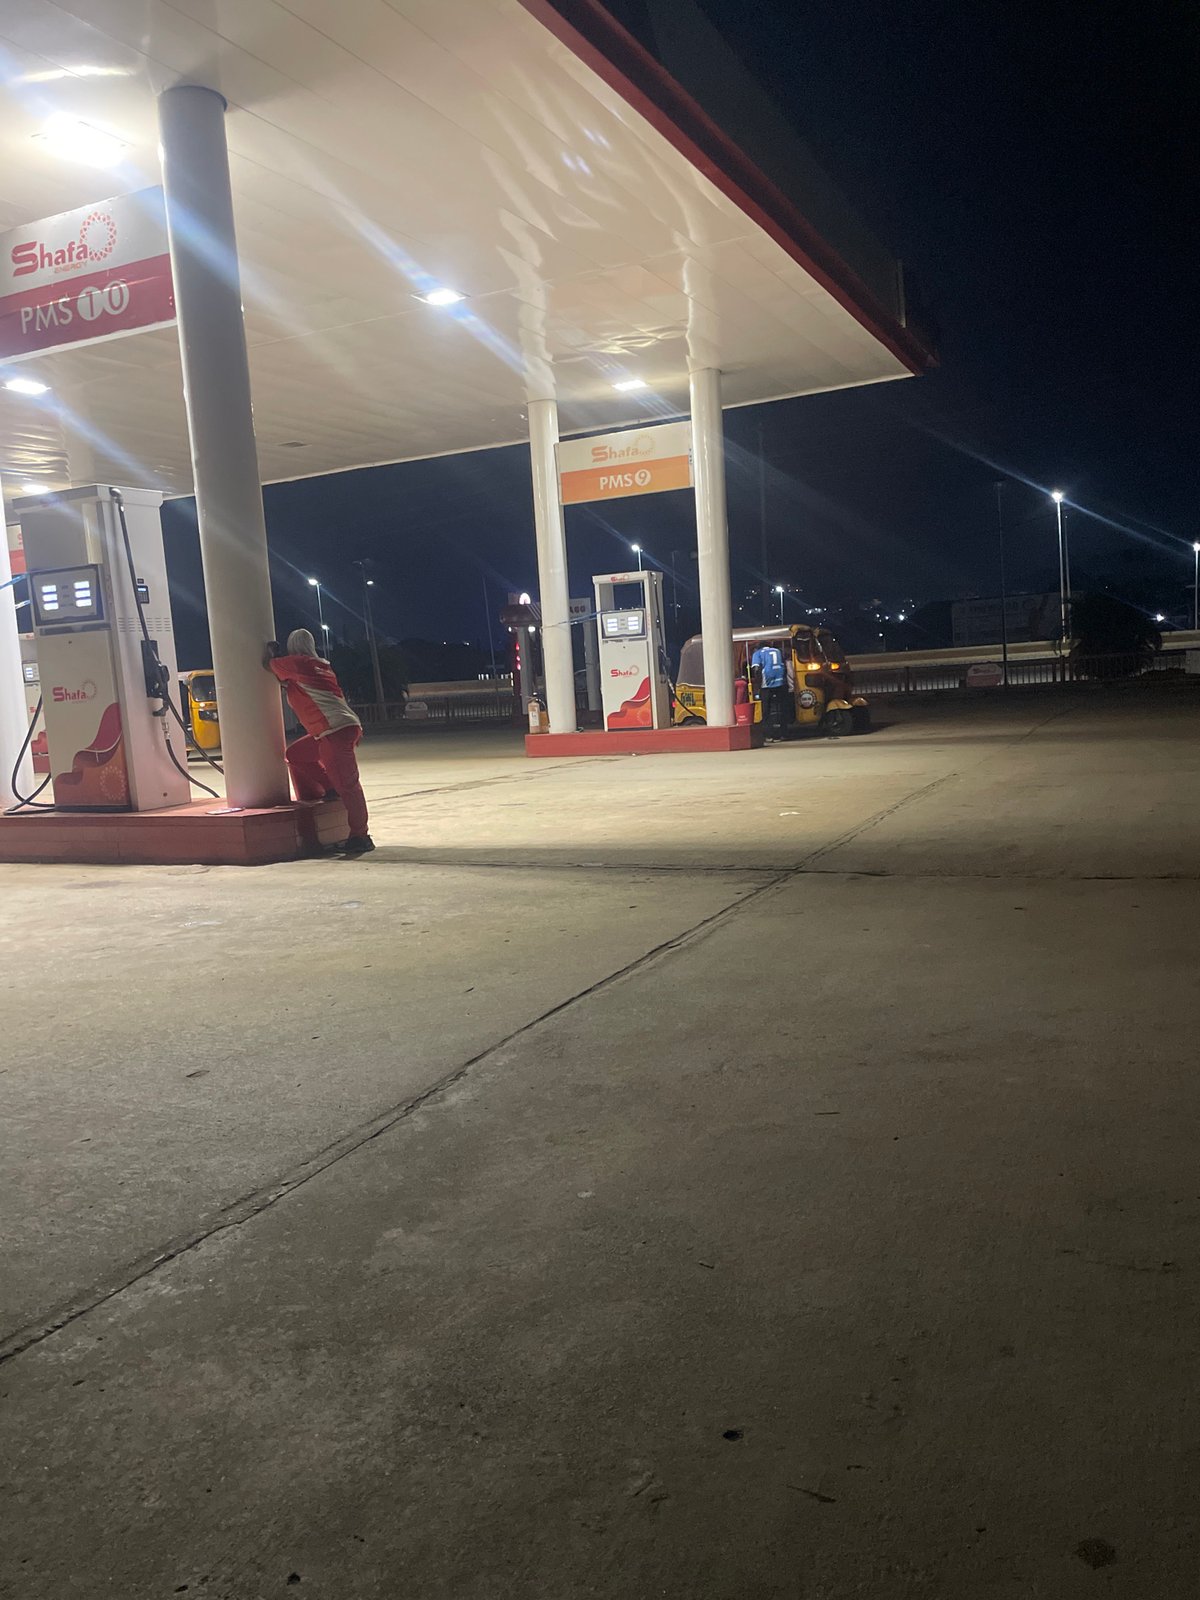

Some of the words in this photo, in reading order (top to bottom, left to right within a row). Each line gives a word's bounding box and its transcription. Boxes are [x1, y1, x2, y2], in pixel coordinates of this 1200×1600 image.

[11, 241, 89, 277] Shafa
[20, 297, 73, 335] PMS
[83, 282, 125, 319] 10
[591, 445, 641, 463] Shafa
[599, 473, 633, 490] PMS
[637, 470, 649, 485] 9
[610, 668, 633, 678] Shafa
[53, 686, 87, 702] Shafa
